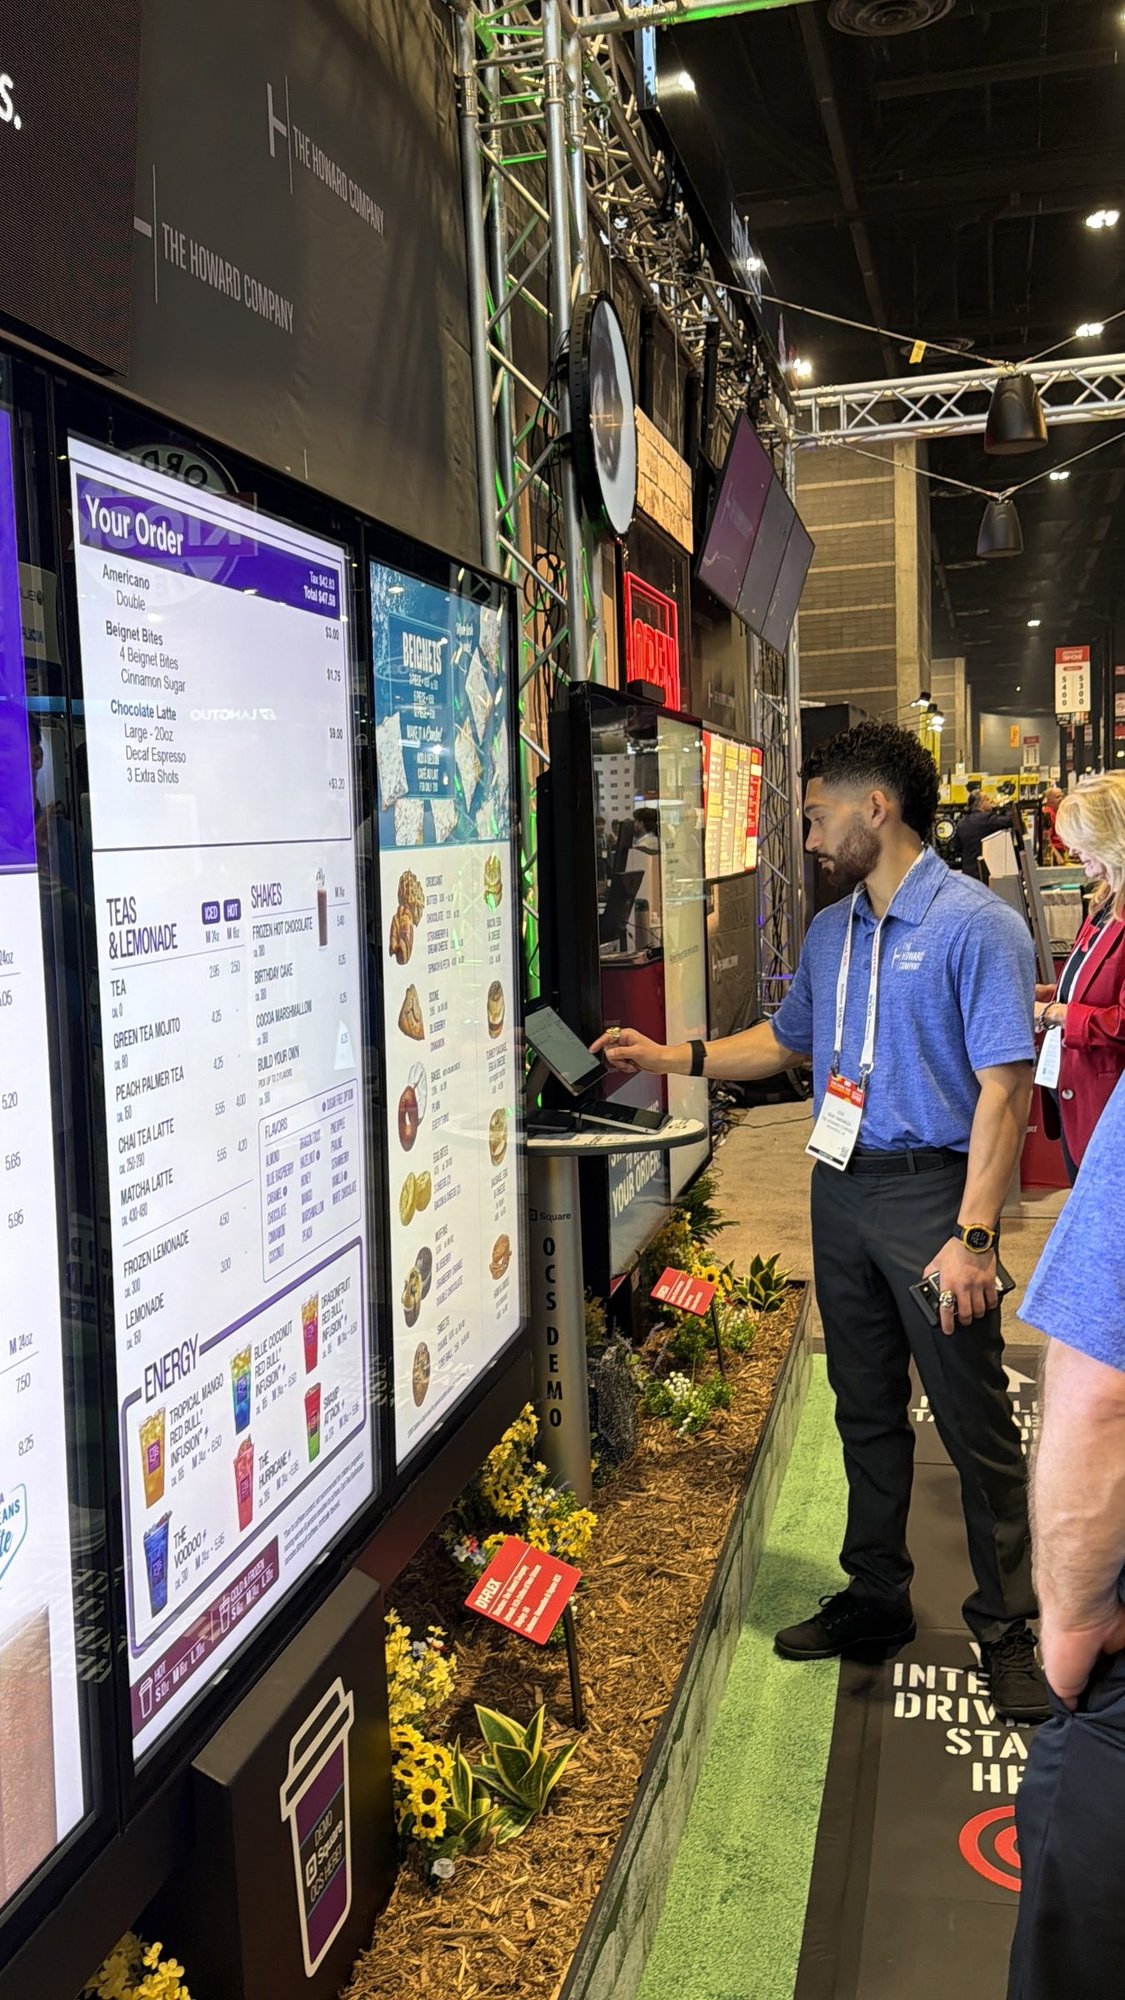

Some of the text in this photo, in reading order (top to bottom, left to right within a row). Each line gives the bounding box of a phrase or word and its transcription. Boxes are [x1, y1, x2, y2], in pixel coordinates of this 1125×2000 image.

[293, 125, 385, 238] THE HOWARD COMPANY
[162, 221, 294, 334] THE HOWARD COMPANY
[85, 494, 184, 556] Your Order
[102, 563, 150, 590] Americano
[309, 571, 319, 585] Tax
[116, 590, 146, 612] Double
[303, 585, 318, 602] Total
[105, 619, 164, 646] Beignet Bites
[119, 646, 179, 671] 4 Beignet Bites
[402, 630, 442, 676] BEIGNETS
[120, 668, 186, 695] Cinnamon Sugar
[327, 668, 342, 682] $1.75
[110, 699, 155, 718] Chocolate
[156, 705, 177, 721] Latte
[124, 723, 148, 743] Large
[154, 726, 174, 742] 20oz
[125, 745, 187, 766] Decaf Espresso
[126, 767, 180, 784] 3 Extra Shots
[250, 882, 283, 909] SHAKES
[106, 896, 137, 928] TEAS
[204, 903, 238, 921] ICED HOT
[109, 922, 178, 960] & LEMONADE
[252, 916, 313, 940] FROZEN HOT CHOCOLATE
[900, 950, 925, 962] HOWARD
[900, 961, 921, 971] COMPANY
[254, 962, 294, 985] BIRTHDAY CAKE
[110, 979, 127, 998] TEA
[113, 1016, 181, 1050] GREEN TEA MOJITO
[255, 1011, 275, 1029] COCOA
[258, 1055, 274, 1072] BUILD
[115, 1065, 185, 1103] PEACH PALMER TEA
[118, 1117, 175, 1154] CHAI TEA LATTE
[120, 1168, 174, 1206] MATCHA LATTE
[612, 1171, 635, 1219] YOUR
[540, 1211, 572, 1222] Square
[123, 1229, 190, 1279] FROZEN LEMONADE
[125, 1292, 165, 1330] LEMONADE
[253, 1319, 293, 1361] BLUE COCONUT
[542, 1237, 563, 1428] OCS DEMO
[9, 1337, 17, 1355] M
[144, 1332, 199, 1404] ENERGY
[254, 1360, 266, 1380] RED
[169, 1372, 225, 1426] TROPICAL MANGO
[169, 1424, 184, 1447] RED
[258, 1450, 270, 1471] THE
[173, 1525, 188, 1550] THE
[173, 1531, 202, 1569] VOODOO
[893, 1691, 1031, 1728] DRIV
